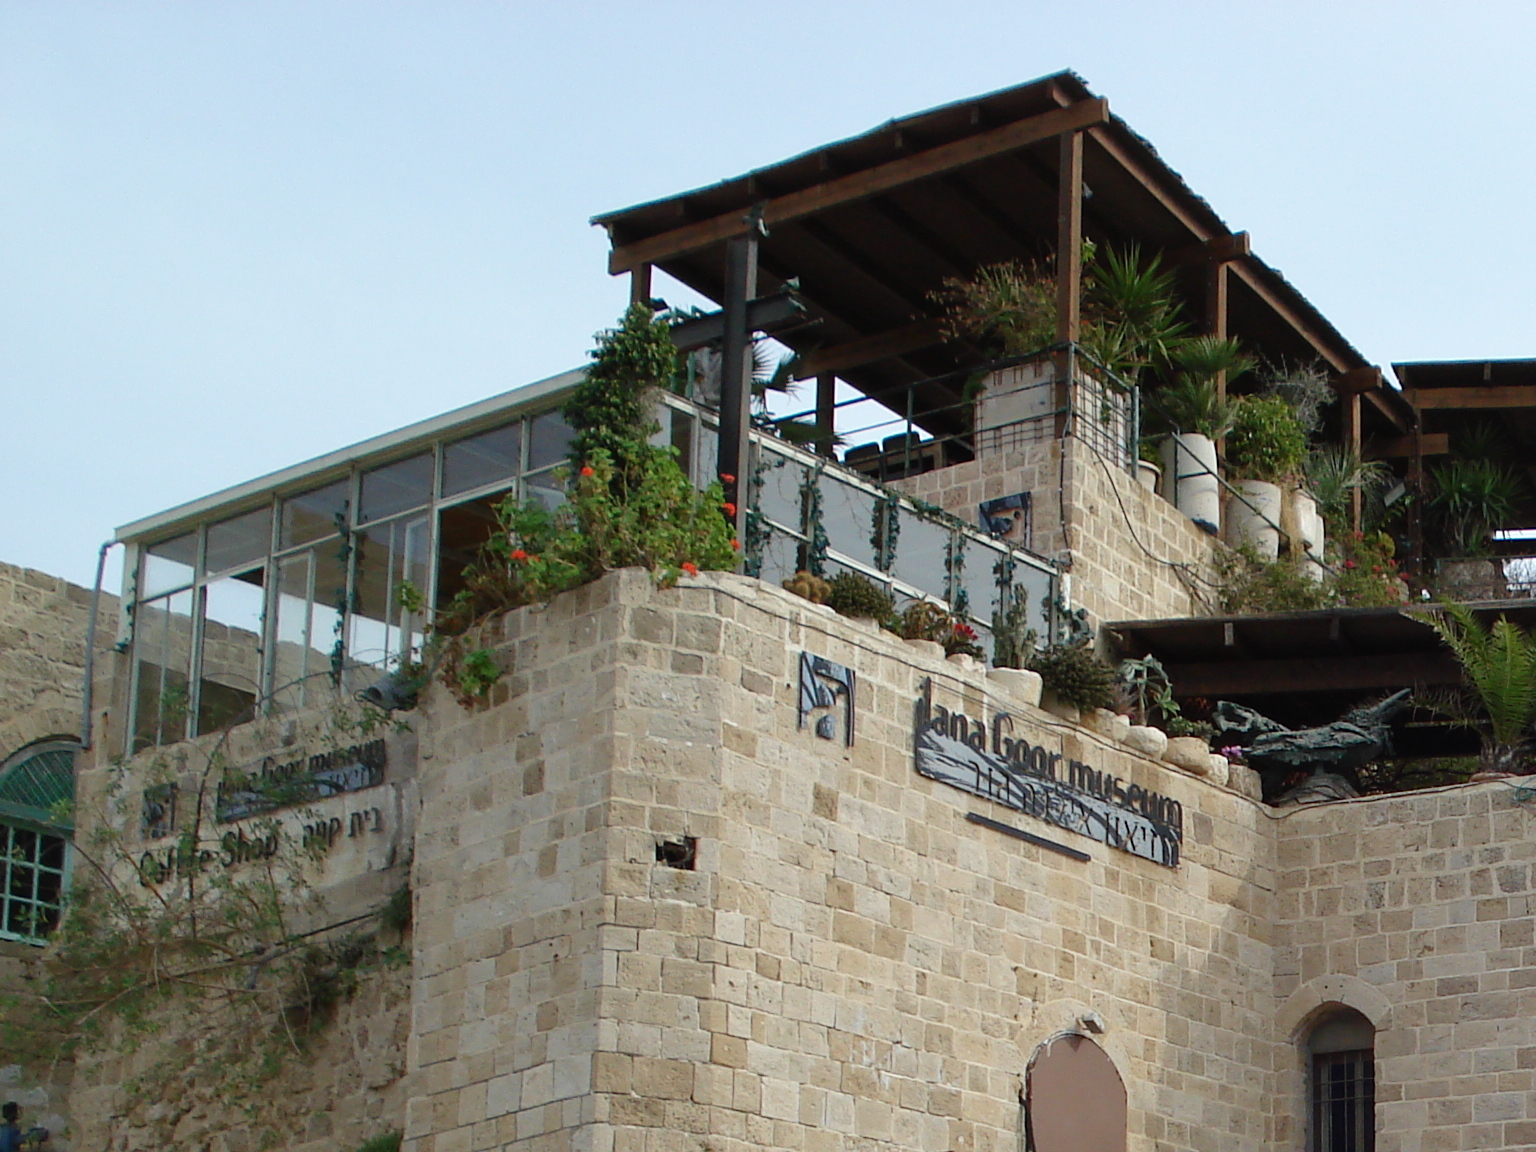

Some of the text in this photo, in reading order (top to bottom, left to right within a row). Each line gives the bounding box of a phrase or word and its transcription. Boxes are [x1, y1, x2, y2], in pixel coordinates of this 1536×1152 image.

[916, 676, 1182, 835] Ilana Goor museum
[967, 759, 1010, 803] גור
[347, 807, 384, 838] בית
